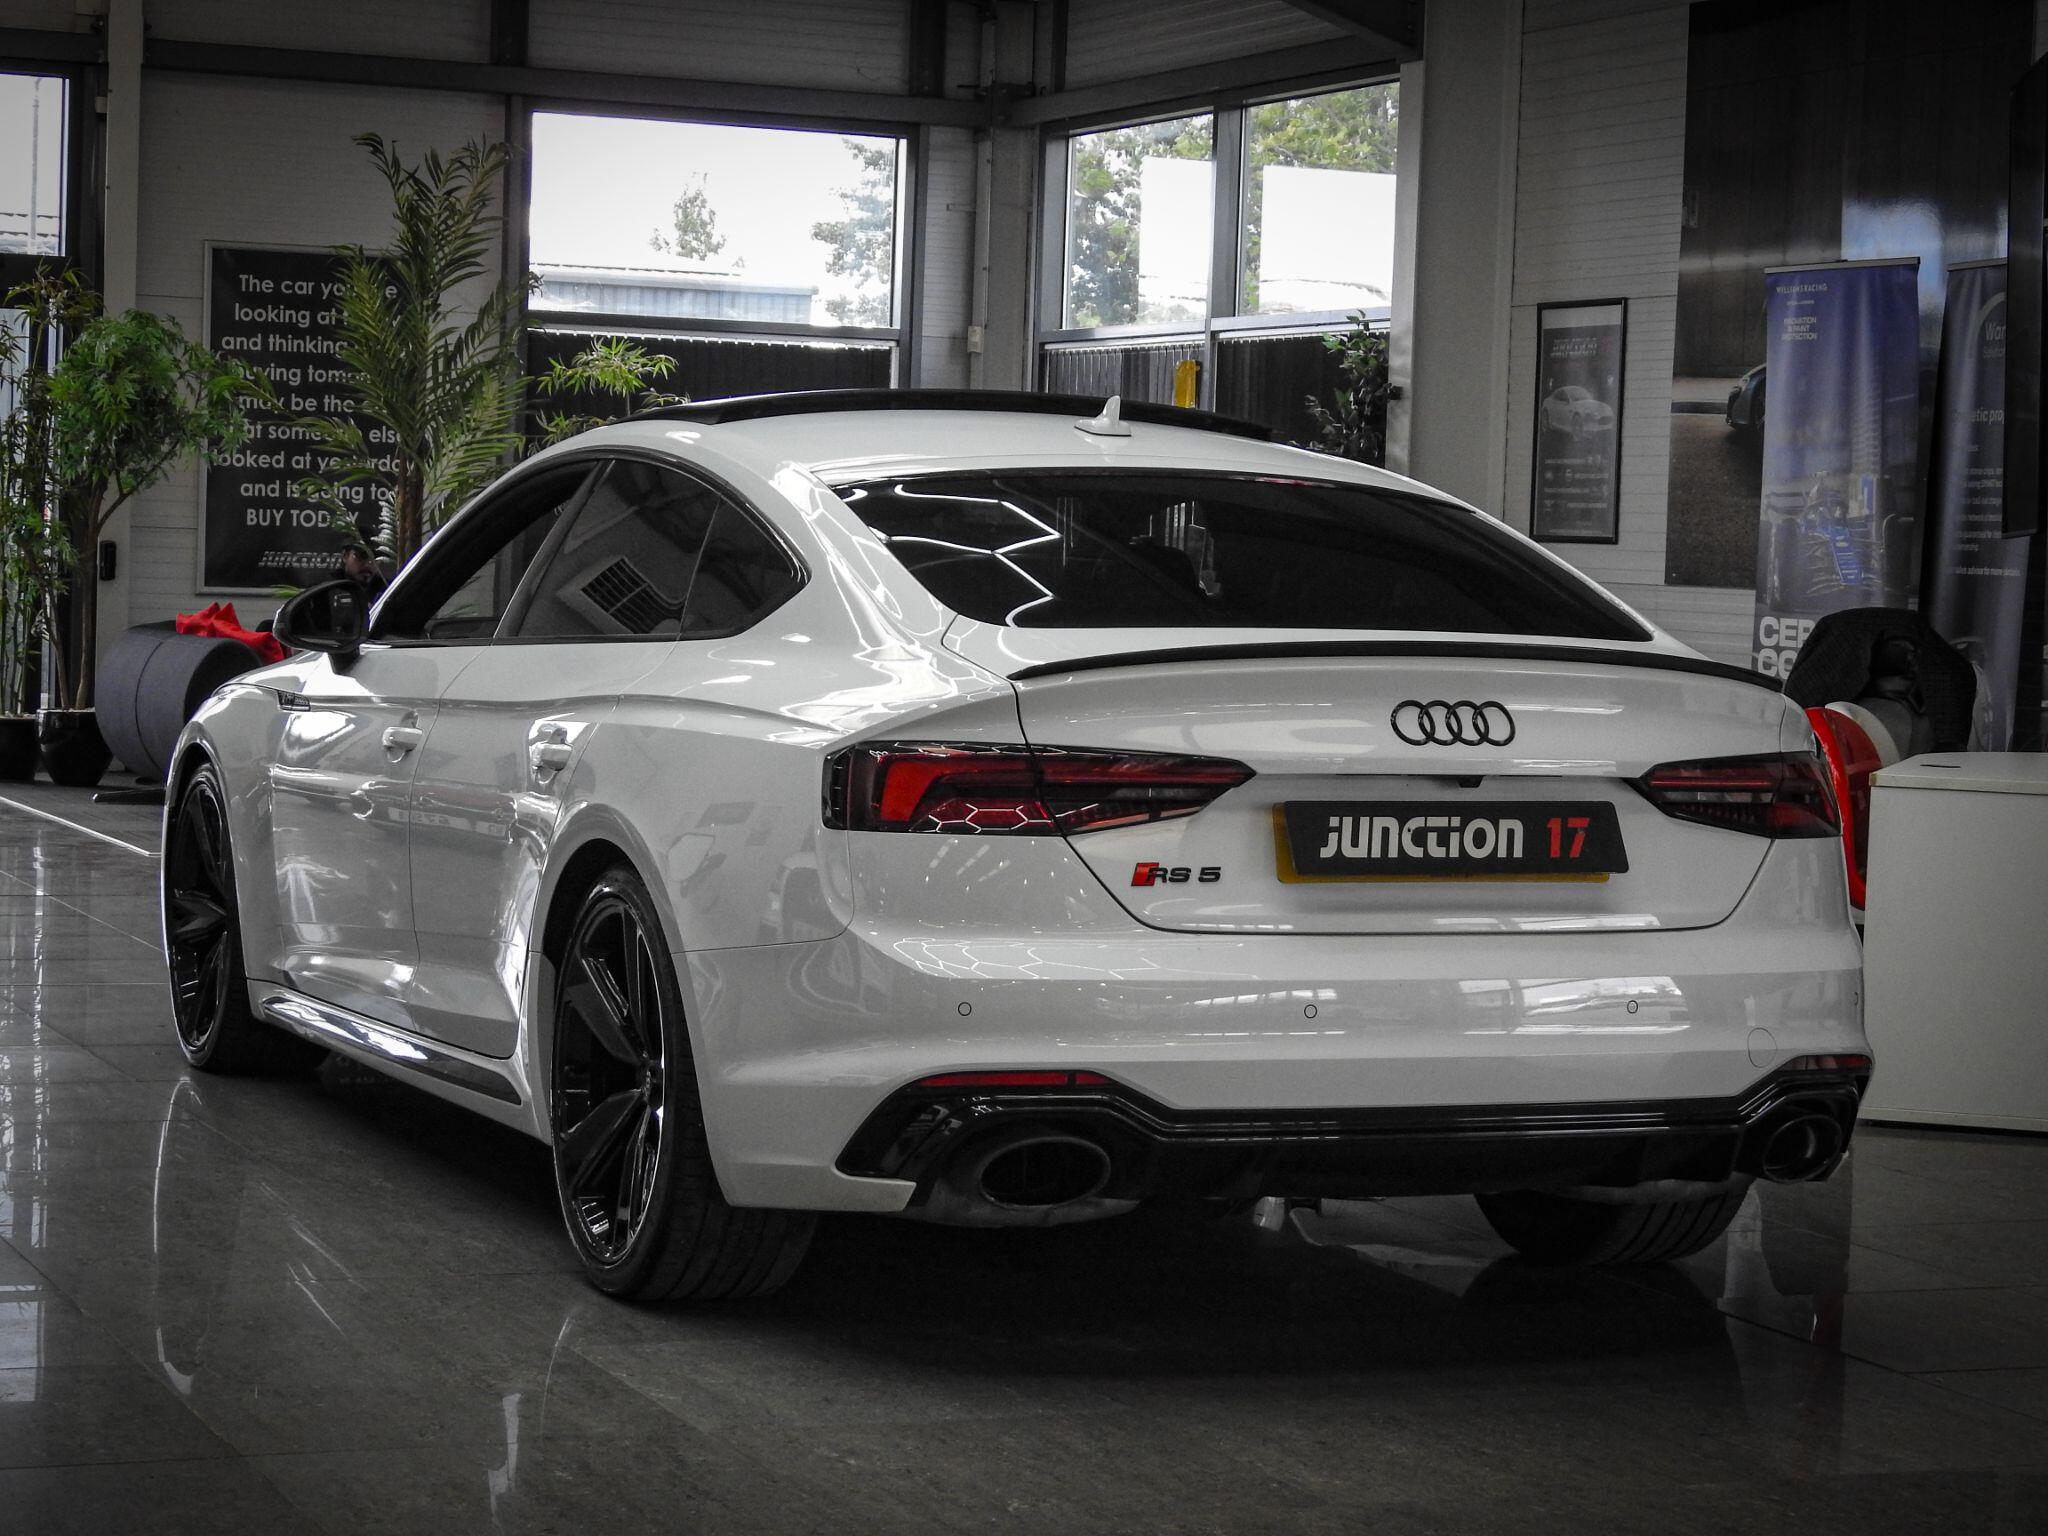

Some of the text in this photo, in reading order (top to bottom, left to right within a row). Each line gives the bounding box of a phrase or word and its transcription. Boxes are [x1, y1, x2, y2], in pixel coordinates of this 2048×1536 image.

[239, 274, 354, 300] The car yo
[235, 303, 310, 328] looking
[317, 308, 336, 325] at
[1985, 322, 2006, 340] War
[221, 333, 348, 358] and thinking
[291, 393, 317, 412] be
[323, 394, 355, 413] the
[292, 452, 311, 469] at
[240, 480, 280, 498] and
[287, 480, 300, 498] is
[371, 484, 391, 501] to
[246, 508, 359, 528] BUY TODY
[1759, 616, 1815, 648] CER
[1547, 817, 1590, 858] 17
[1141, 865, 1222, 884] RS 5
